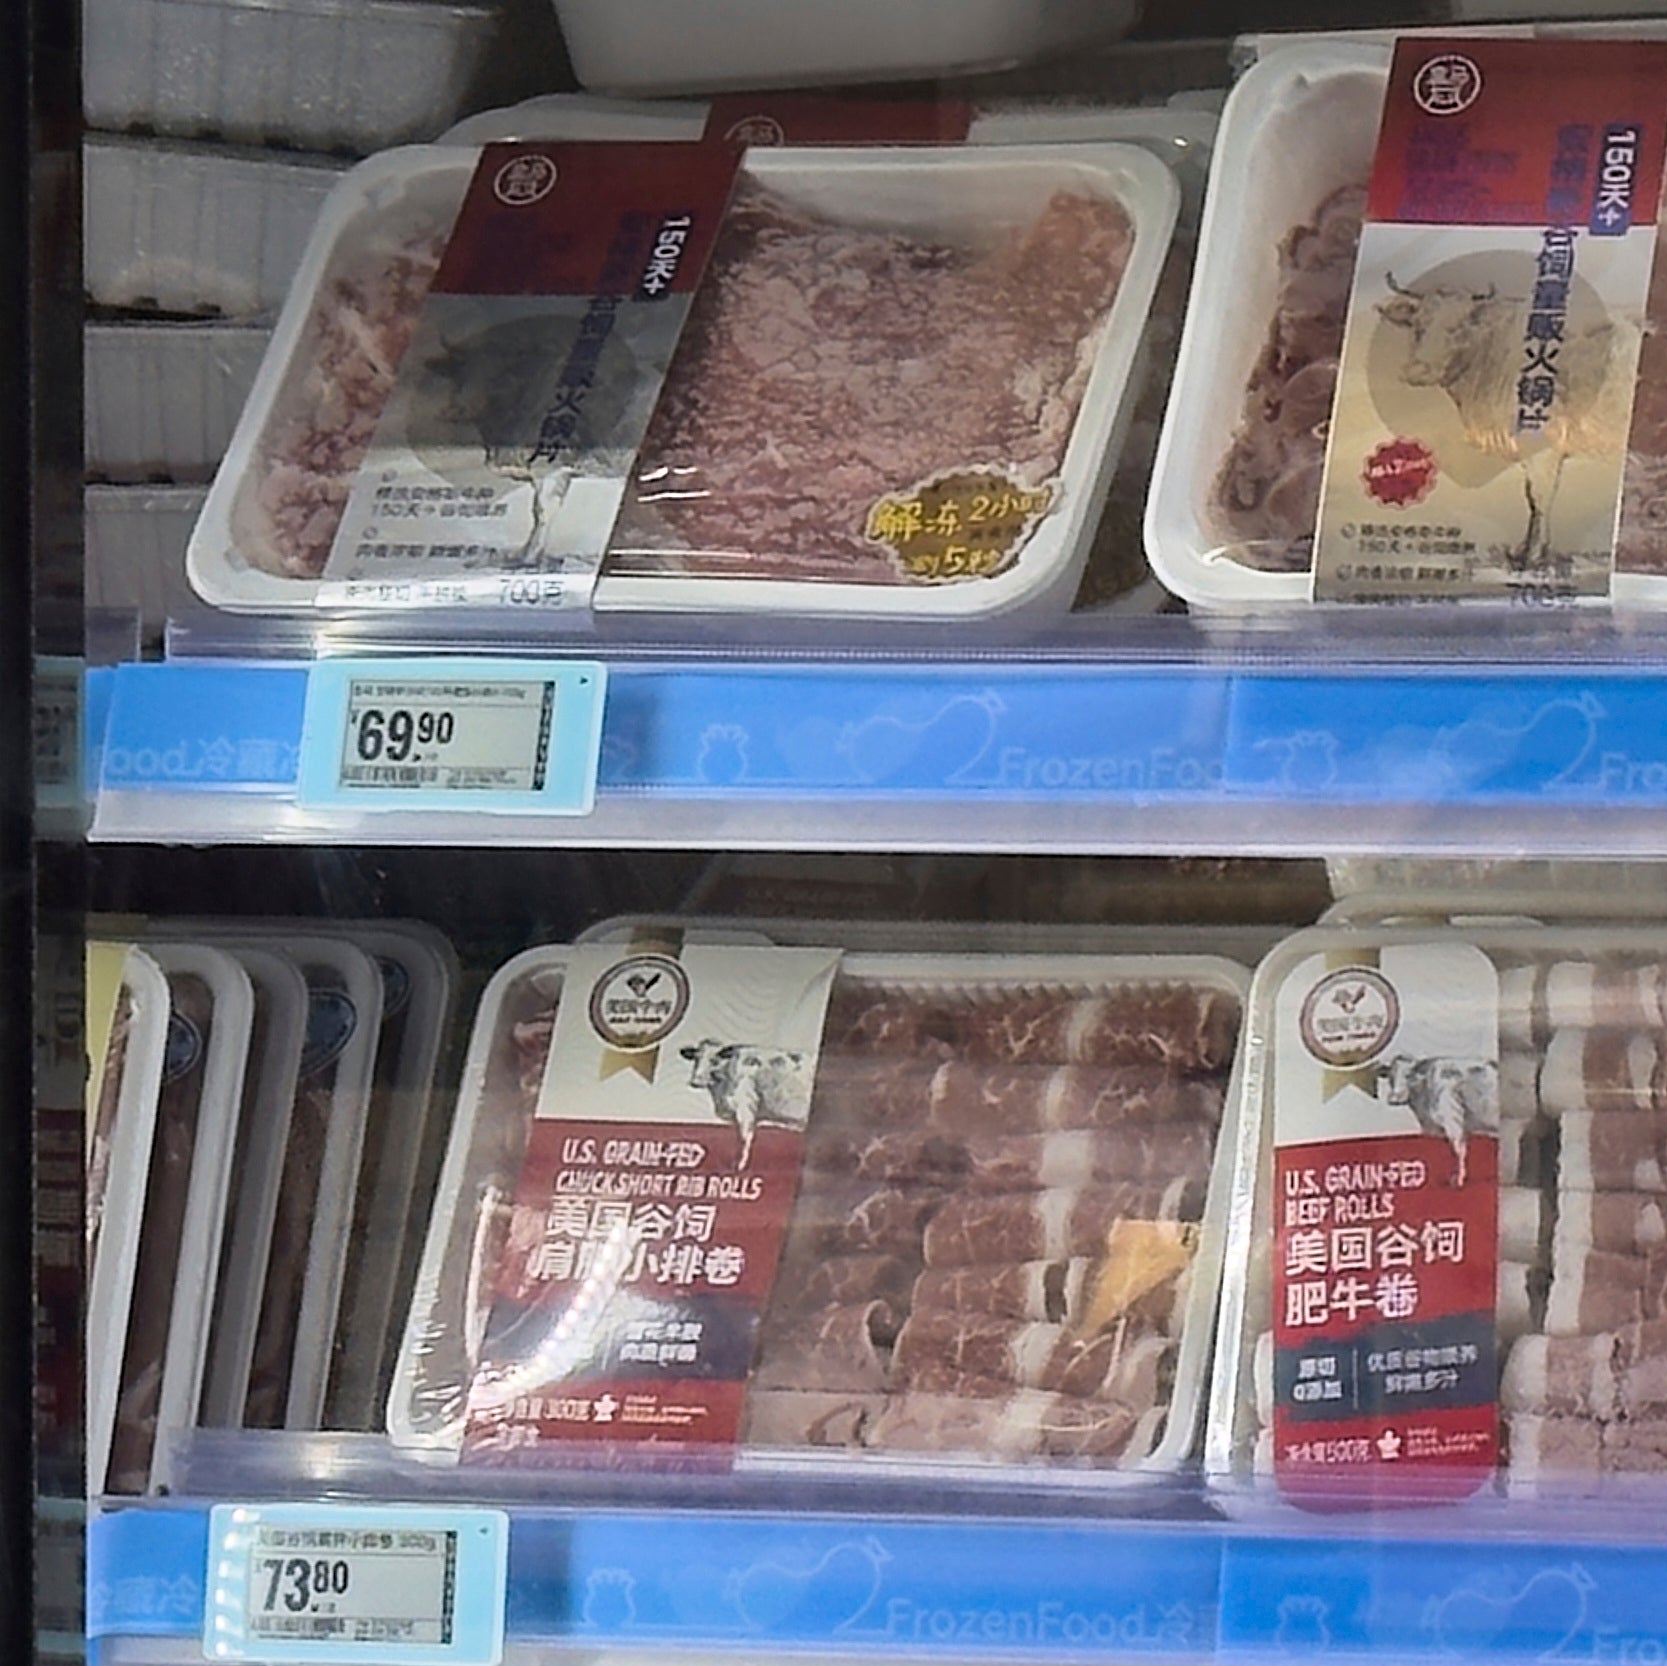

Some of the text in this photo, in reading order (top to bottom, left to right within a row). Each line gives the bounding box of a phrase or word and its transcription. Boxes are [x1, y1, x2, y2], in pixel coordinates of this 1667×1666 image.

[707, 1177, 764, 1200] ROLLS
[1285, 1170, 1320, 1197] U.S.
[546, 1195, 716, 1242] 美国谷饲
[1334, 1193, 1395, 1223] ROLLS
[1285, 1220, 1465, 1276] 美国谷饲
[1285, 1272, 1418, 1327] 肥牛卷
